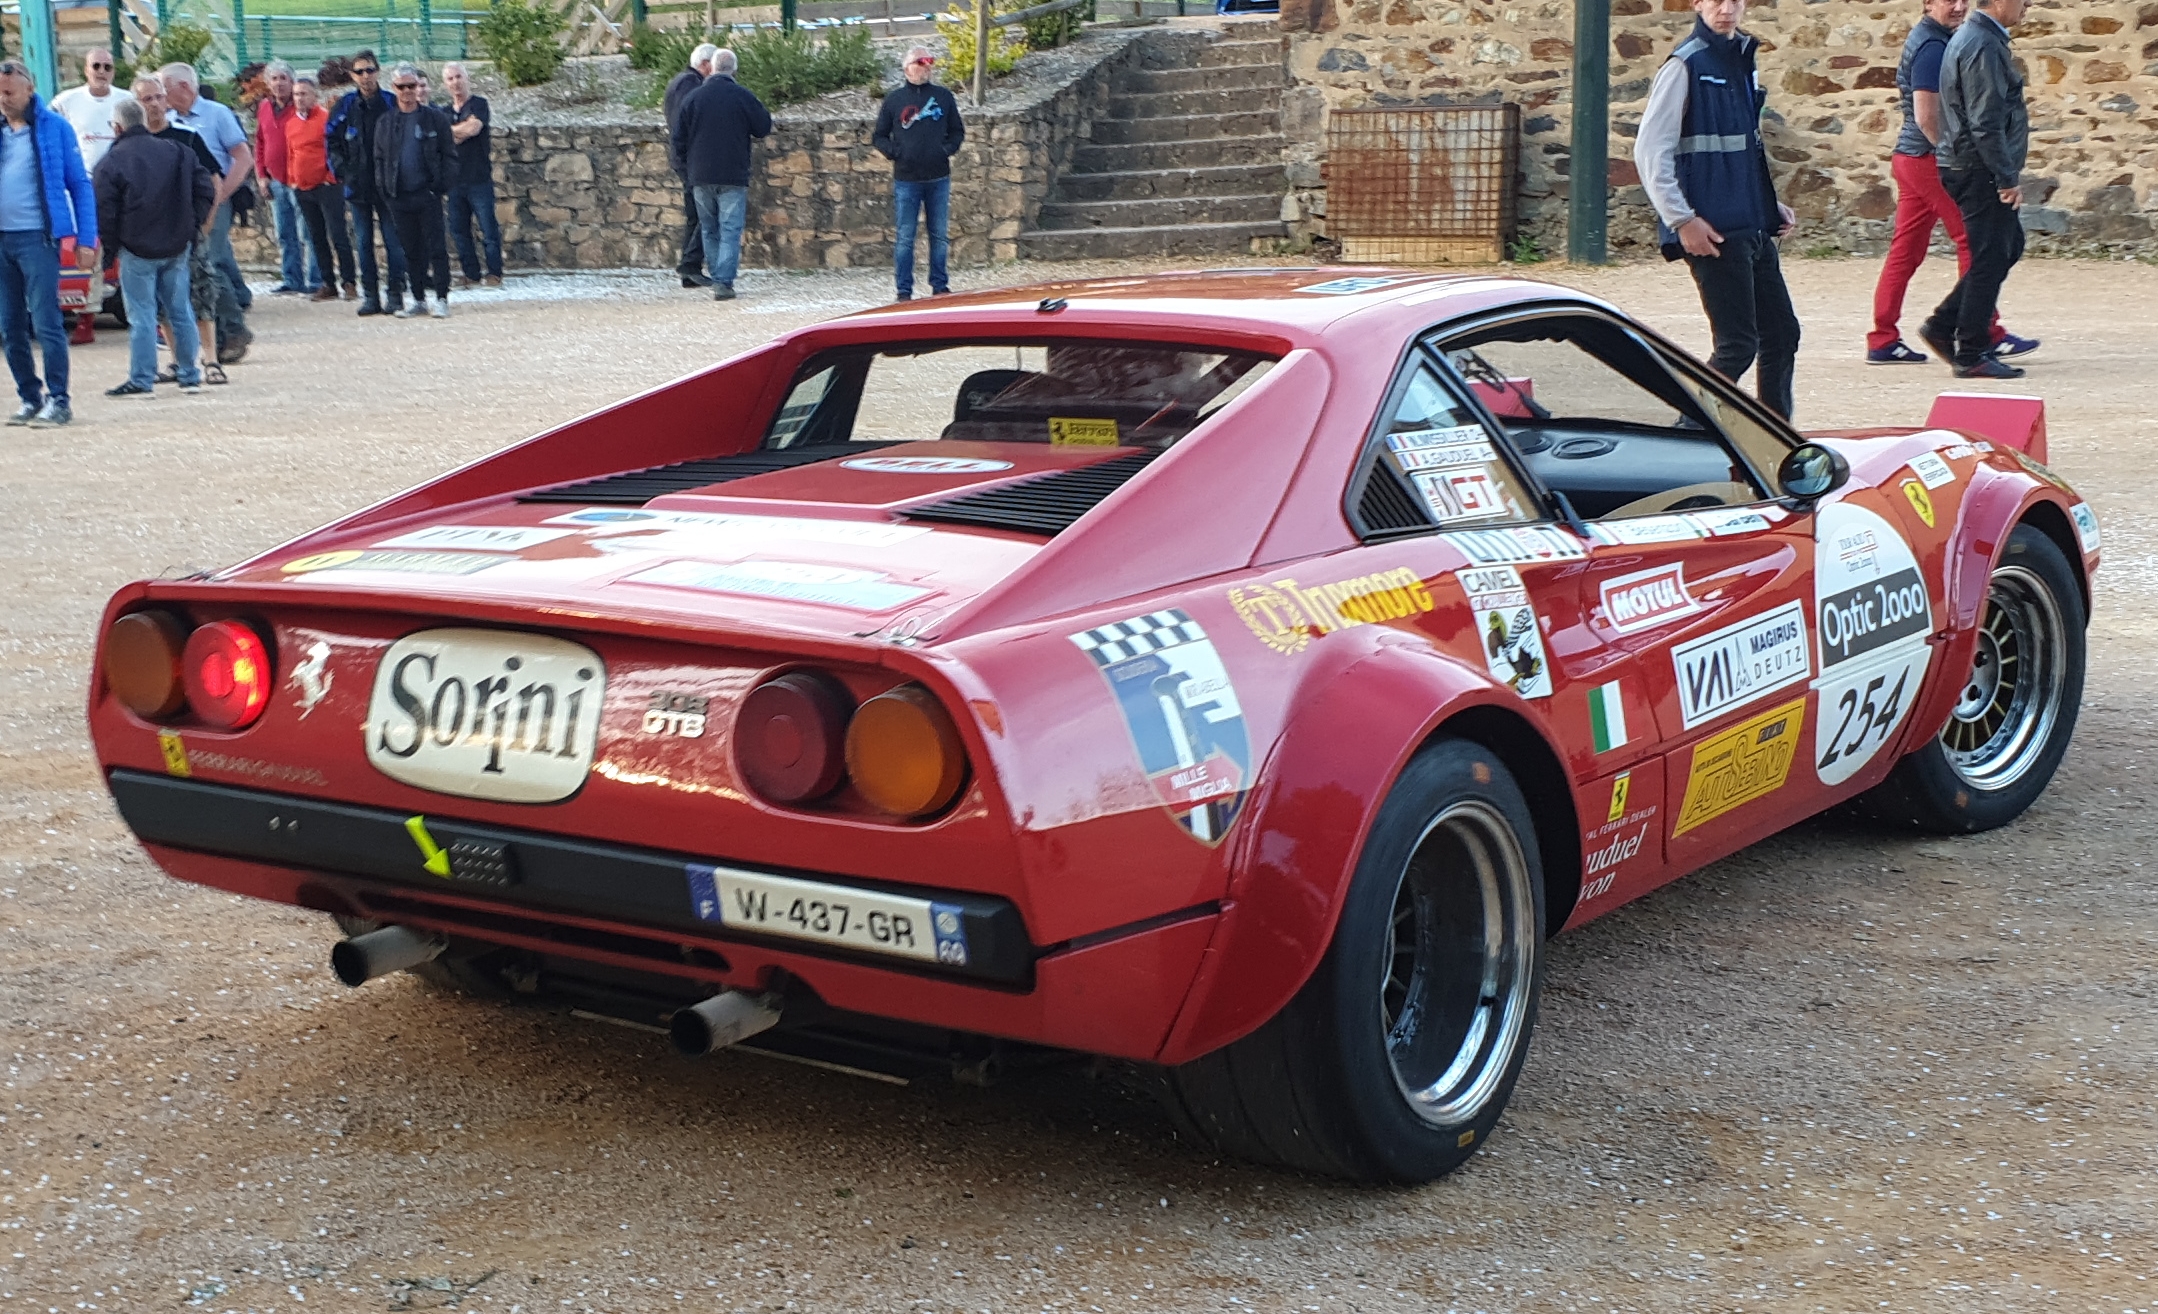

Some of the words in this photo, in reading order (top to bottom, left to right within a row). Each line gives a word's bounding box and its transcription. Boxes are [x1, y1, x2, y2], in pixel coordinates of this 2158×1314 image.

[1463, 570, 1522, 593] CAMEL
[1611, 577, 1684, 622] MOTUL
[1823, 590, 1877, 656] Optic
[1875, 583, 1925, 628] 2000
[1750, 621, 1798, 655] MAGIRUS
[1754, 645, 1803, 680] DEUTZ
[648, 690, 710, 714] 308
[1818, 664, 1910, 770] 254
[641, 709, 706, 738] GTB
[1170, 765, 1208, 790] MILLE
[700, 899, 714, 920] F
[735, 887, 914, 948] W-437-GR
[938, 939, 966, 965] 69
